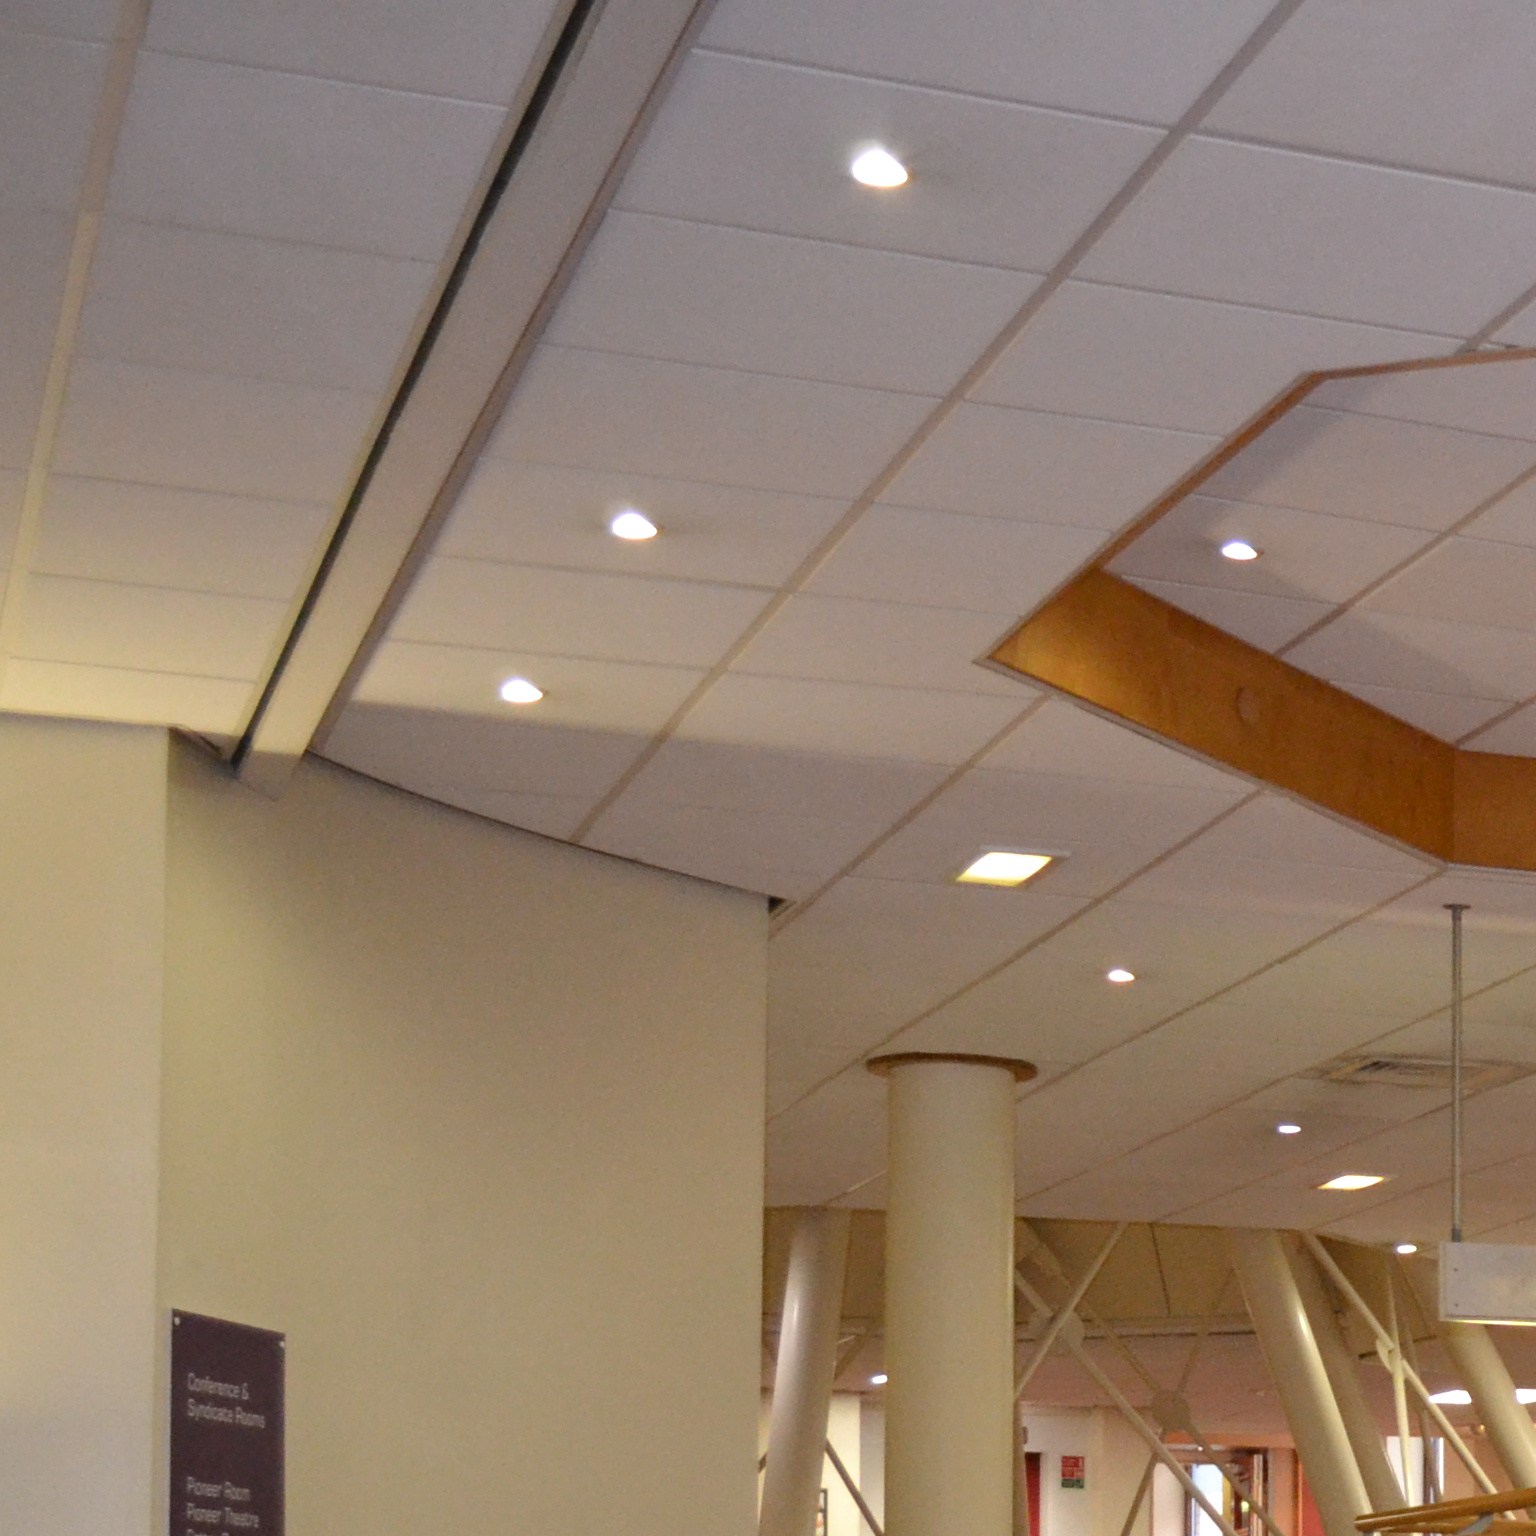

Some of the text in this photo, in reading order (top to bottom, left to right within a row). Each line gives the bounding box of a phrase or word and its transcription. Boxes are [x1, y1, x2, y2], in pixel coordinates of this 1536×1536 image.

[188, 1372, 249, 1400] Conference &
[187, 1398, 266, 1429] Syndicate Rooms
[187, 1476, 250, 1502] Pioneer Room
[186, 1502, 260, 1529] Pioneer Theatre
